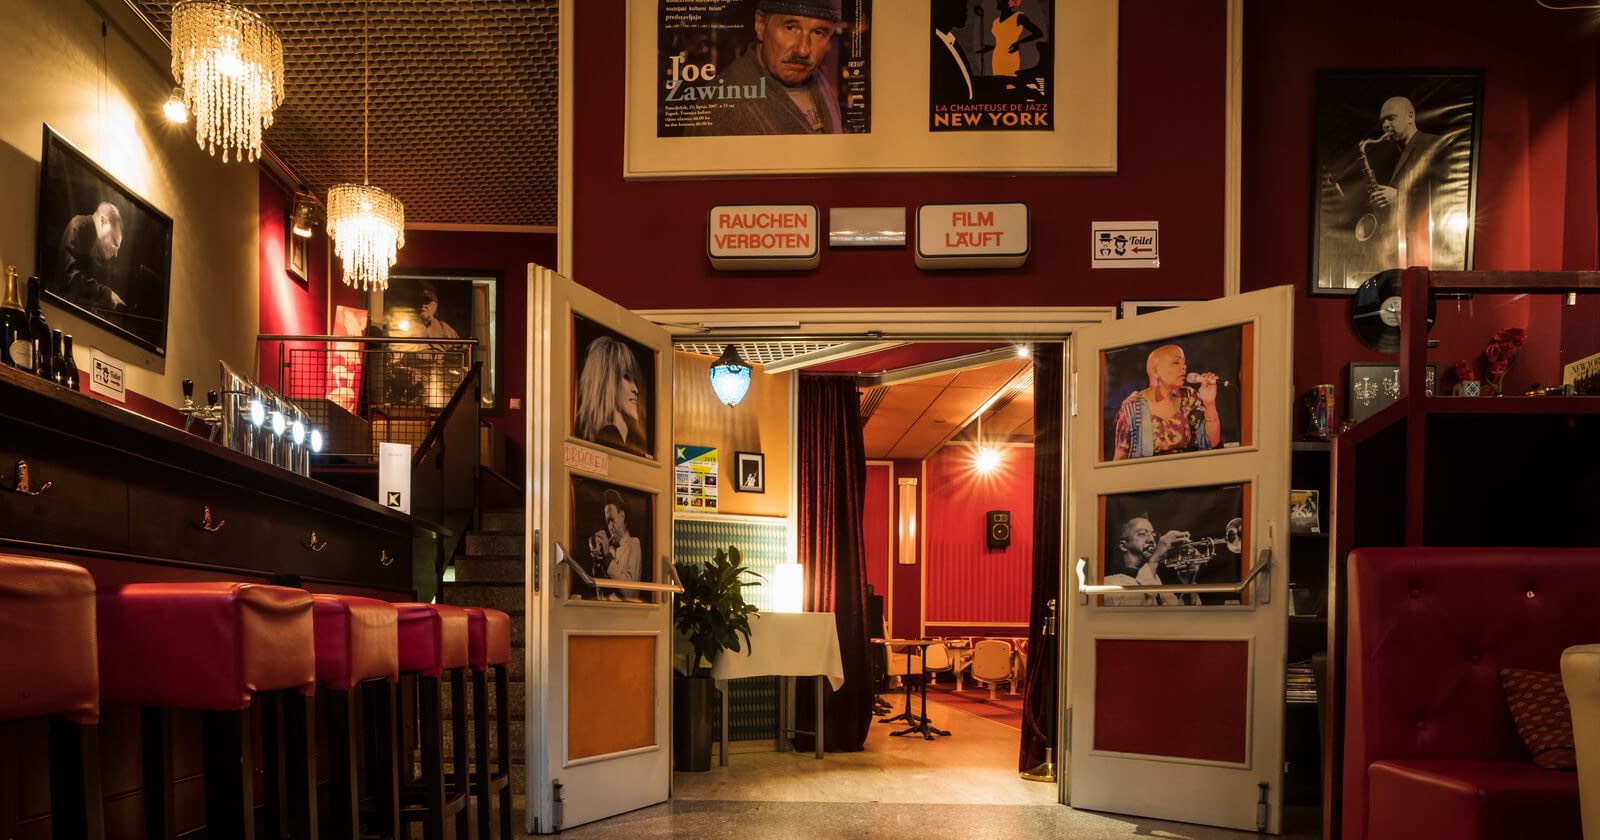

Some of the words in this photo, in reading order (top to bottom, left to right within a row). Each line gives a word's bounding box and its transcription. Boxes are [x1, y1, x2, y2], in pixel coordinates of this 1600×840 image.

[665, 56, 716, 89] Joe
[664, 76, 767, 102] Zawinul
[935, 104, 948, 112] LA
[949, 103, 1007, 112] CHANTEUSE
[1009, 103, 1023, 112] DE
[1024, 103, 1048, 112] JAZZ
[934, 112, 983, 127] NEW
[988, 112, 1048, 126] YORK
[719, 213, 807, 229] RAUCHEN
[952, 211, 994, 227] FILM
[714, 233, 810, 249] VERBOTEN
[945, 231, 1004, 248] LÄUFT
[1129, 236, 1153, 245] Toilet
